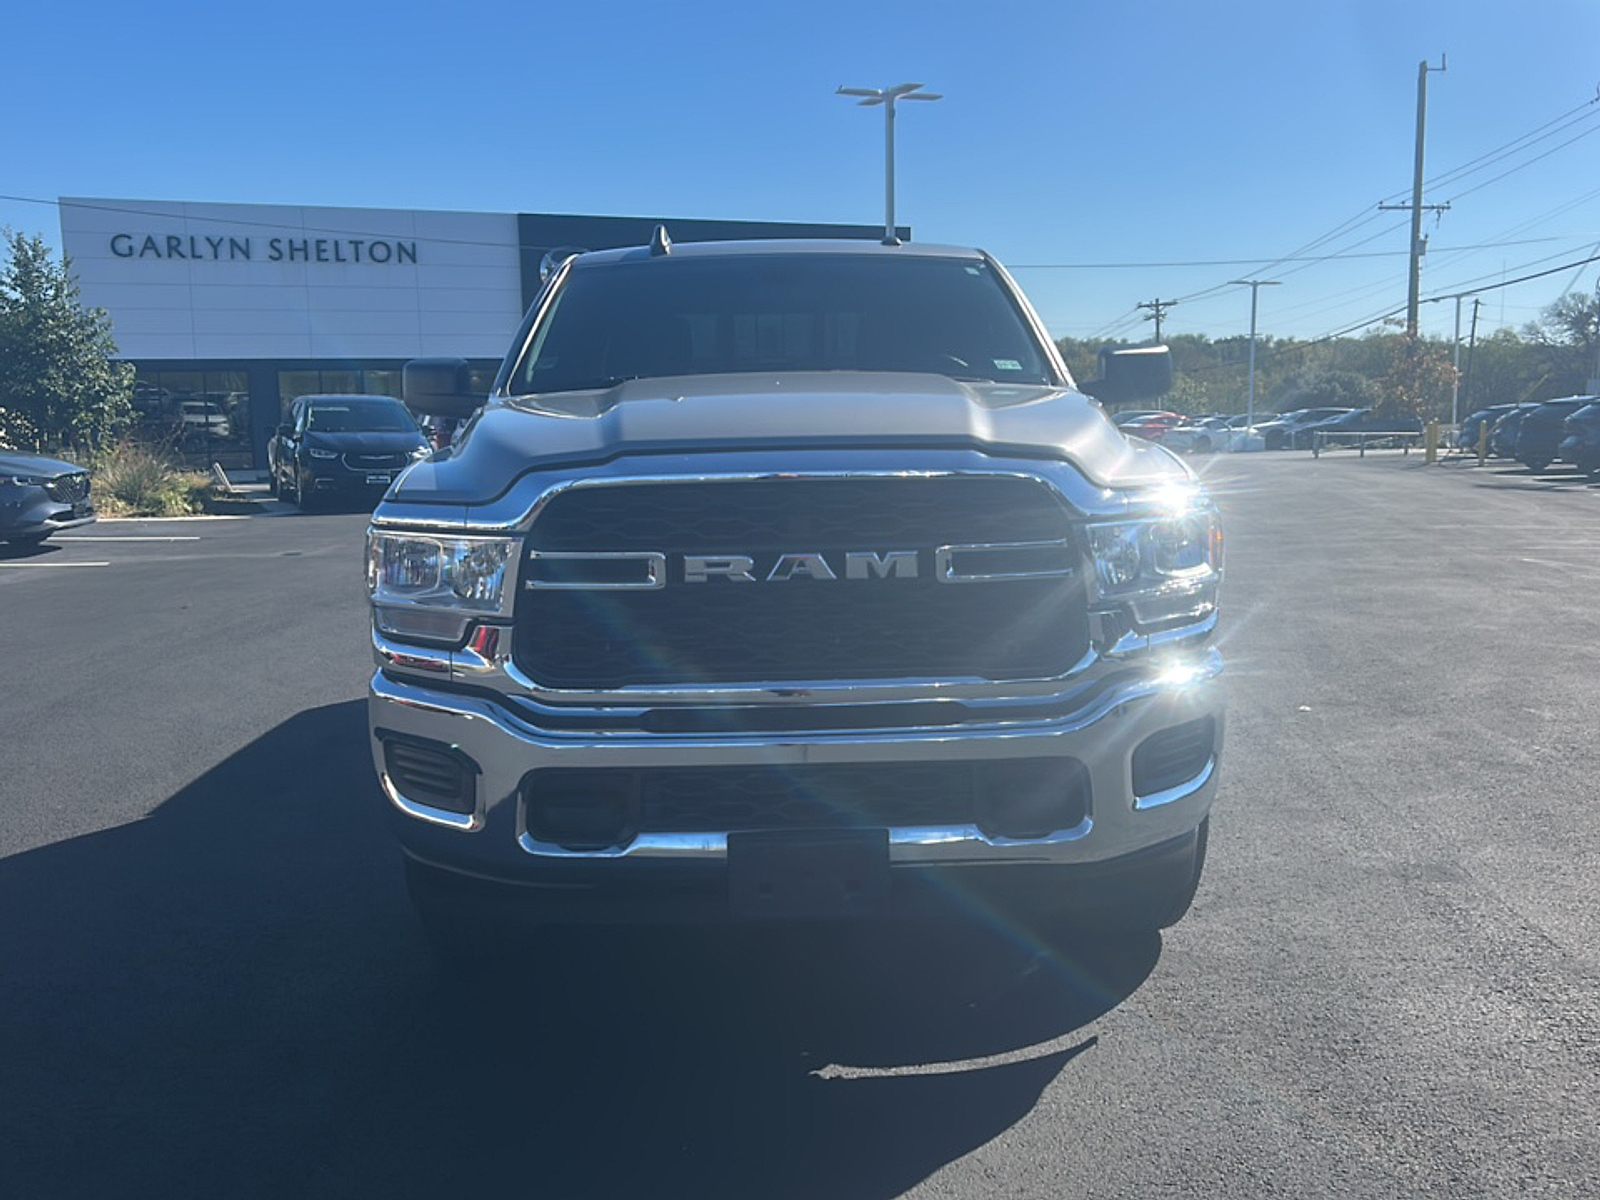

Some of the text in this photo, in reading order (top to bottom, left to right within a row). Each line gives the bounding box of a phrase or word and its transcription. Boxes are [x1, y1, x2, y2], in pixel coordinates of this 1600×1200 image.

[110, 234, 417, 264] GARLYN SHELTON
[684, 551, 918, 582] RAM
